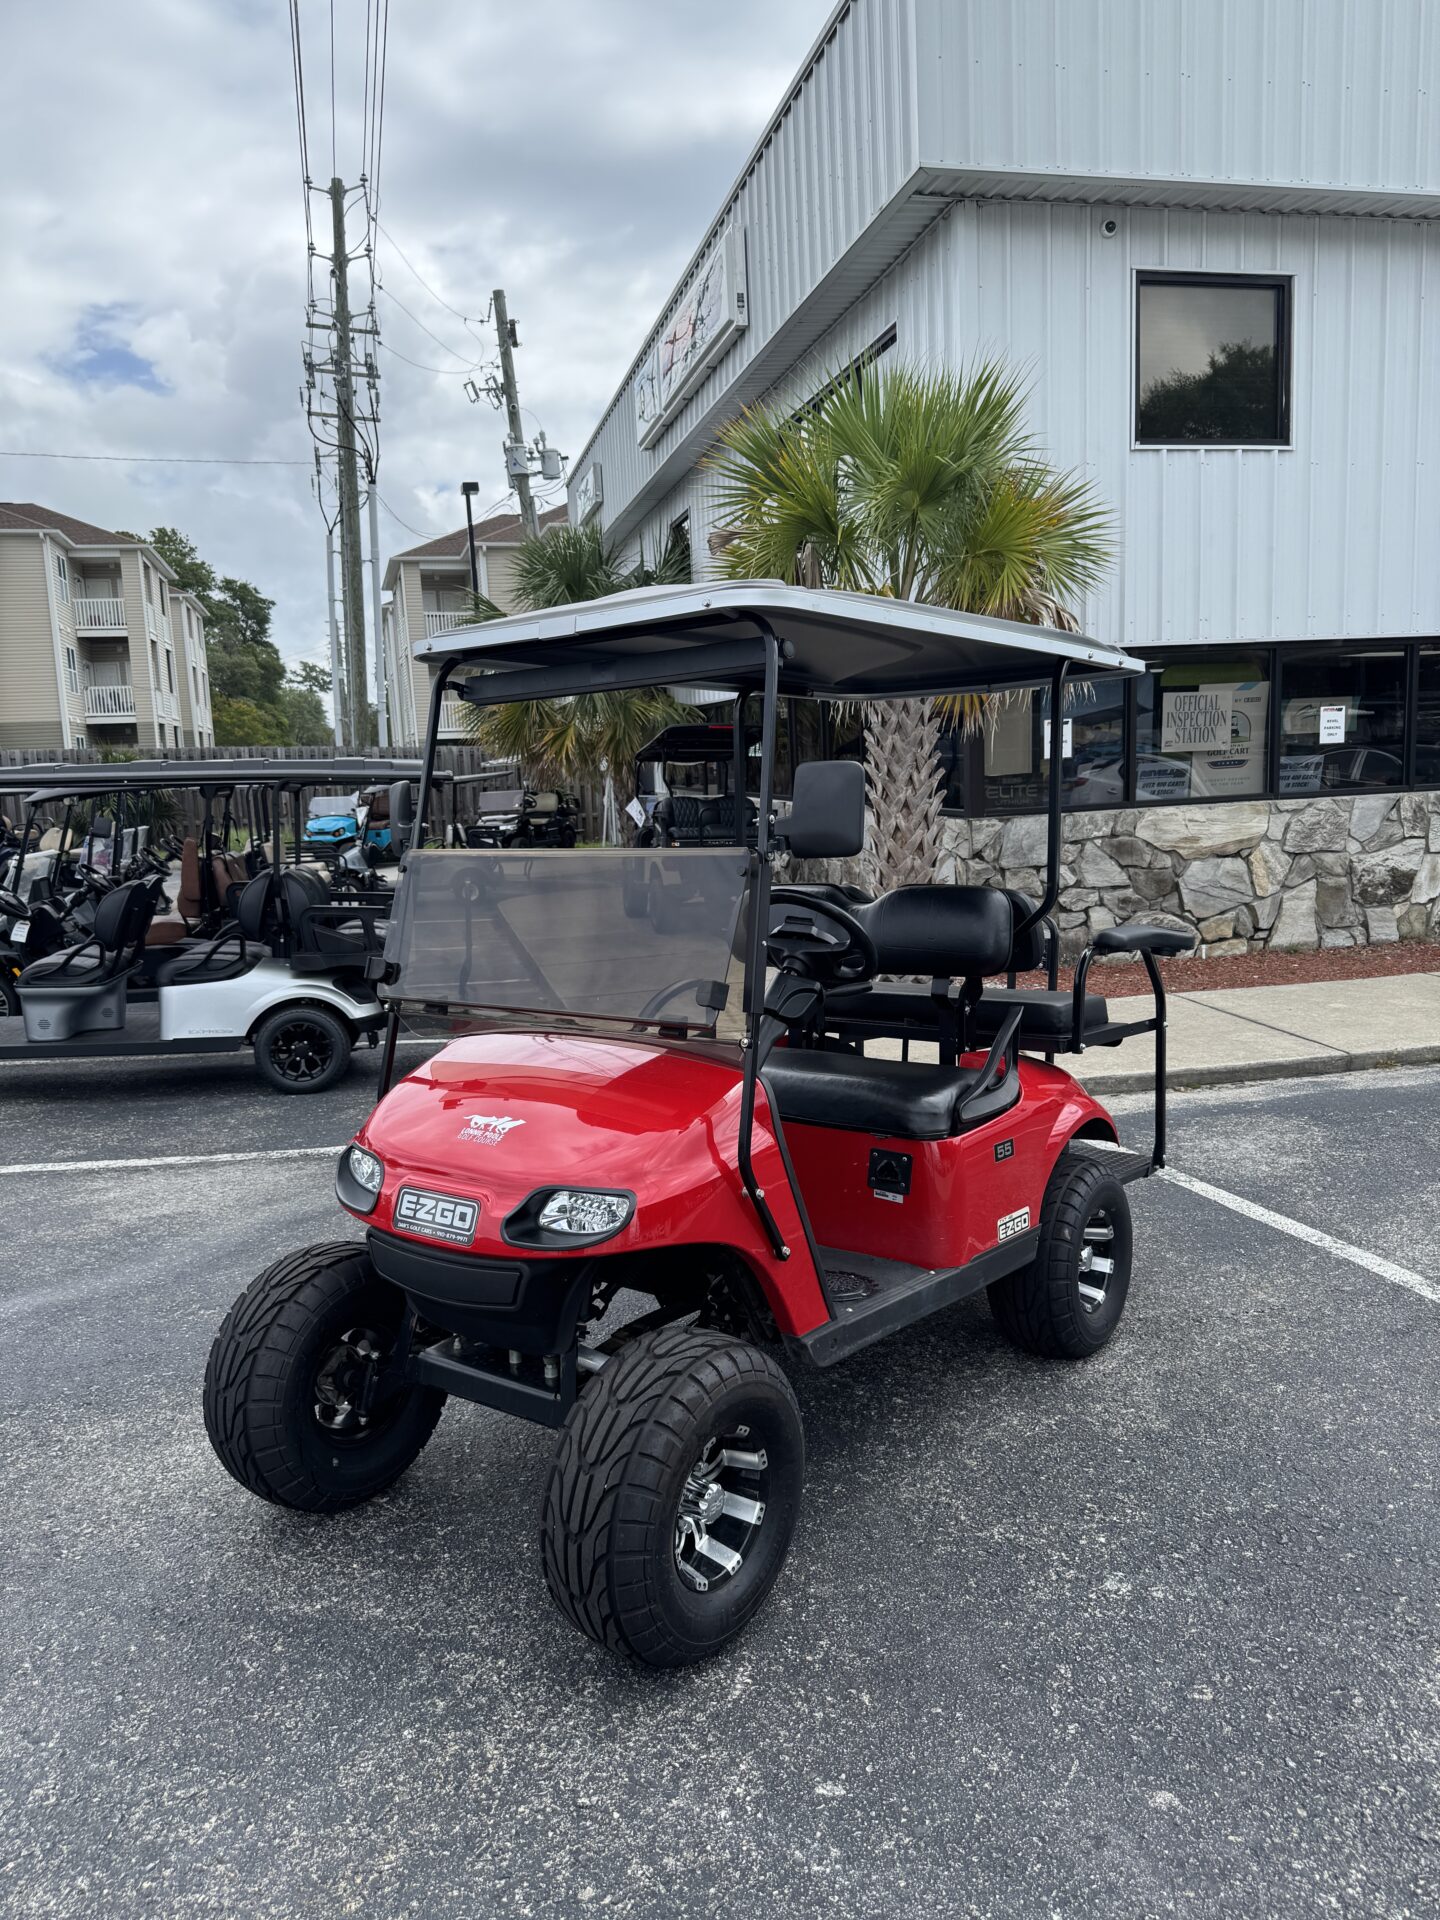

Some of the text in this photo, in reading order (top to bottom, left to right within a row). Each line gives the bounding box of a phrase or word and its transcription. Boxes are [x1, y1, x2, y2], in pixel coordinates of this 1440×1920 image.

[1174, 694, 1221, 712] OFFICIAL
[1166, 710, 1227, 728] INSPECTION
[1174, 726, 1217, 744] STATION
[1229, 747, 1250, 755] CART
[457, 1133, 498, 1146] GOLF COURSE
[461, 1127, 504, 1142] LONNIE POOLE
[997, 1142, 1012, 1158] 55
